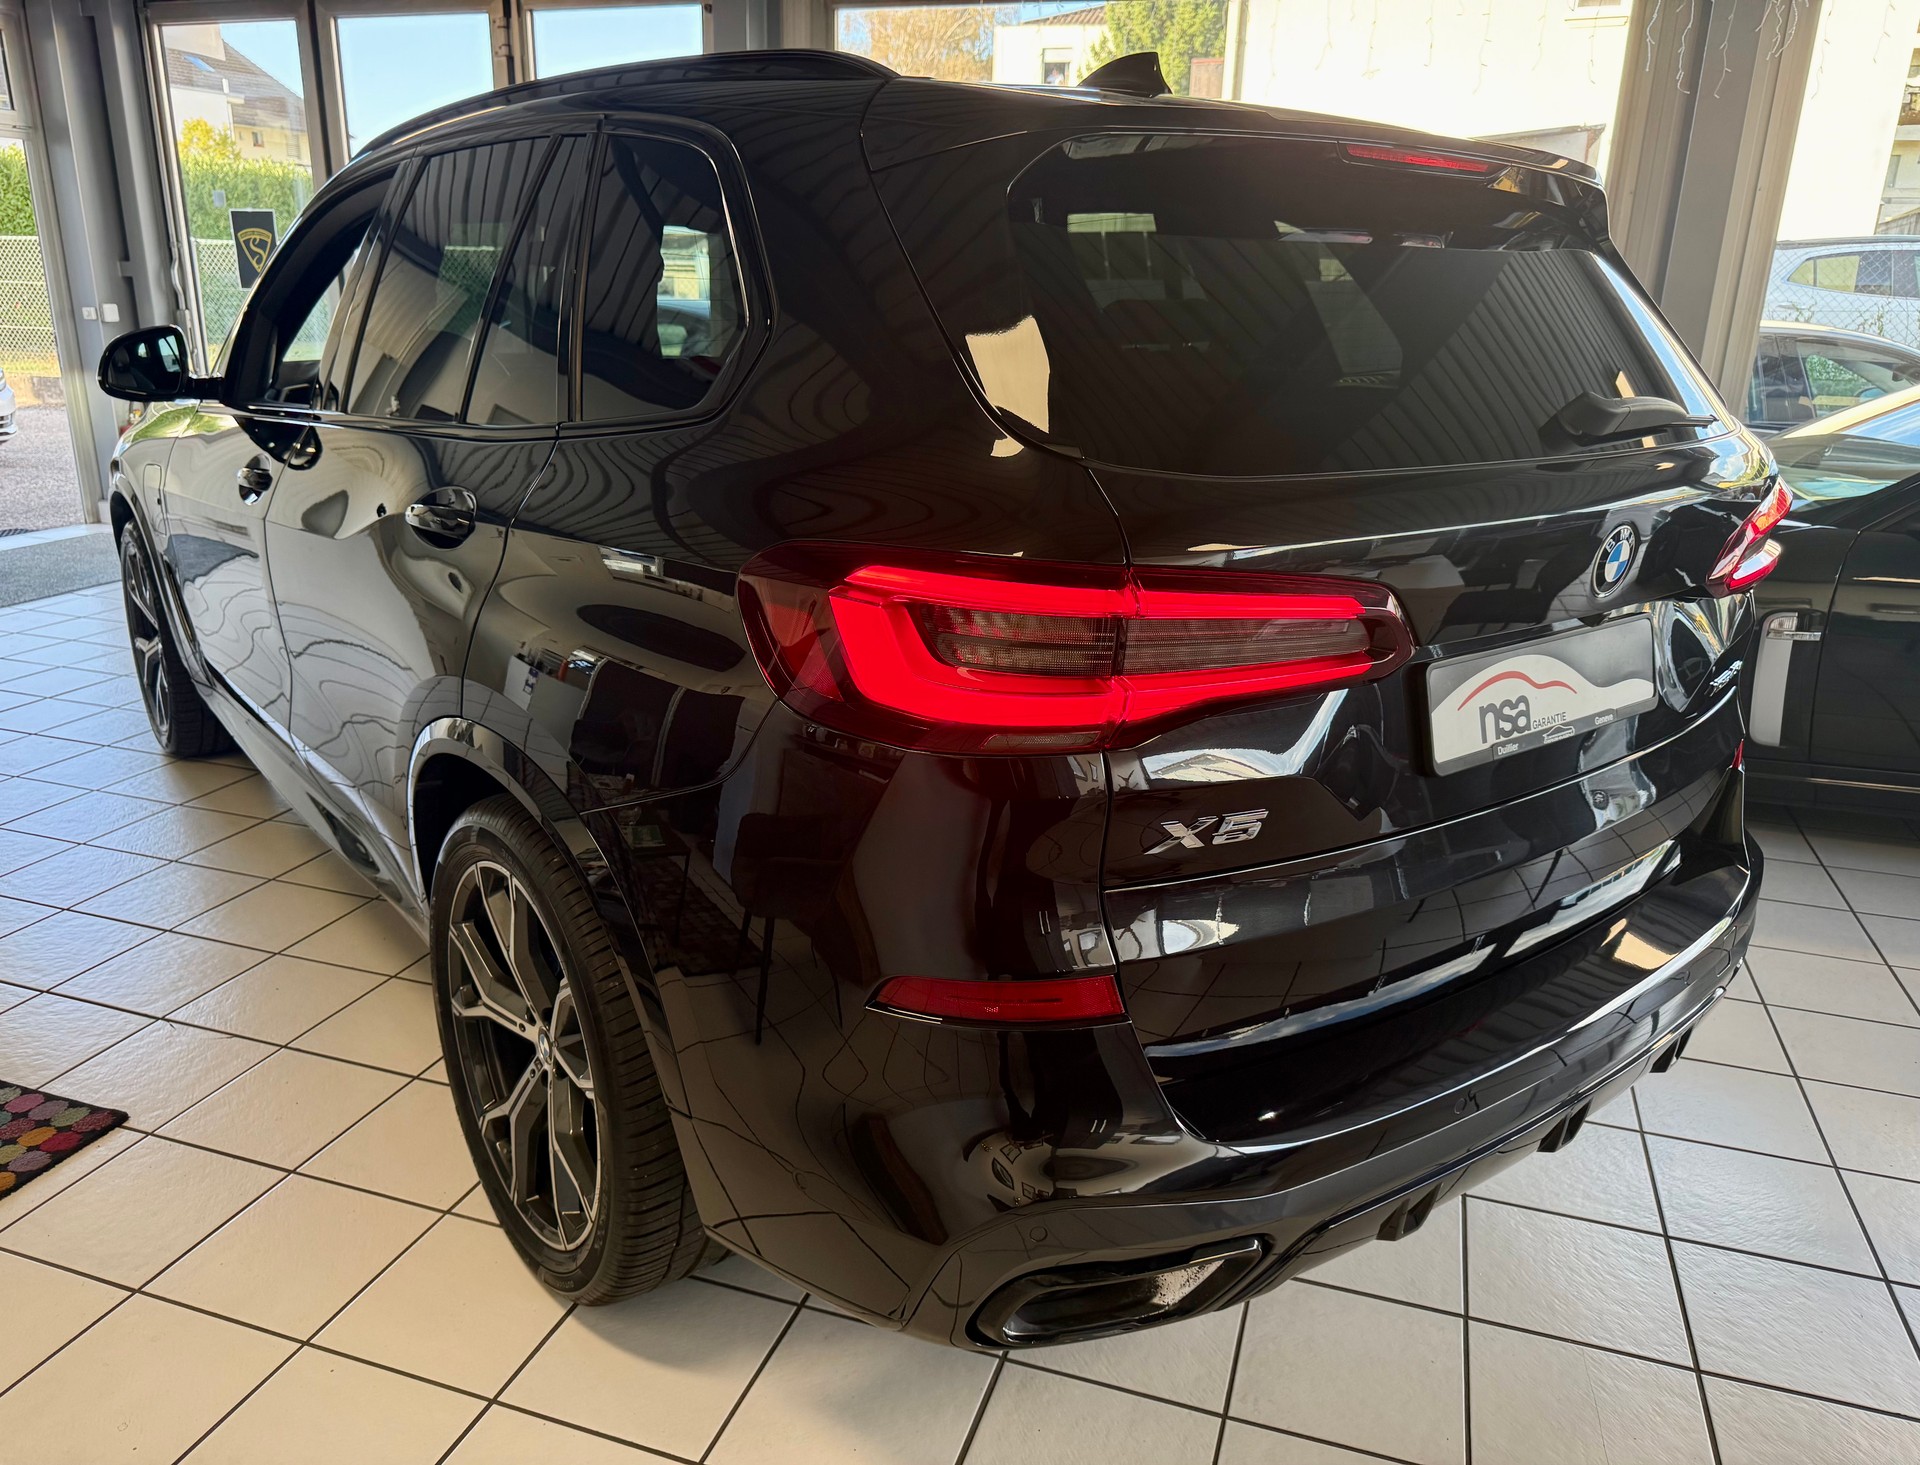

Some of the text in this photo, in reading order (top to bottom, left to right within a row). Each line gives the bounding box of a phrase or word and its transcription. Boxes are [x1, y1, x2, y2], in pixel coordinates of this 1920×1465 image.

[1479, 694, 1567, 744] nsa GARANTIE
[1143, 808, 1269, 855] X5
